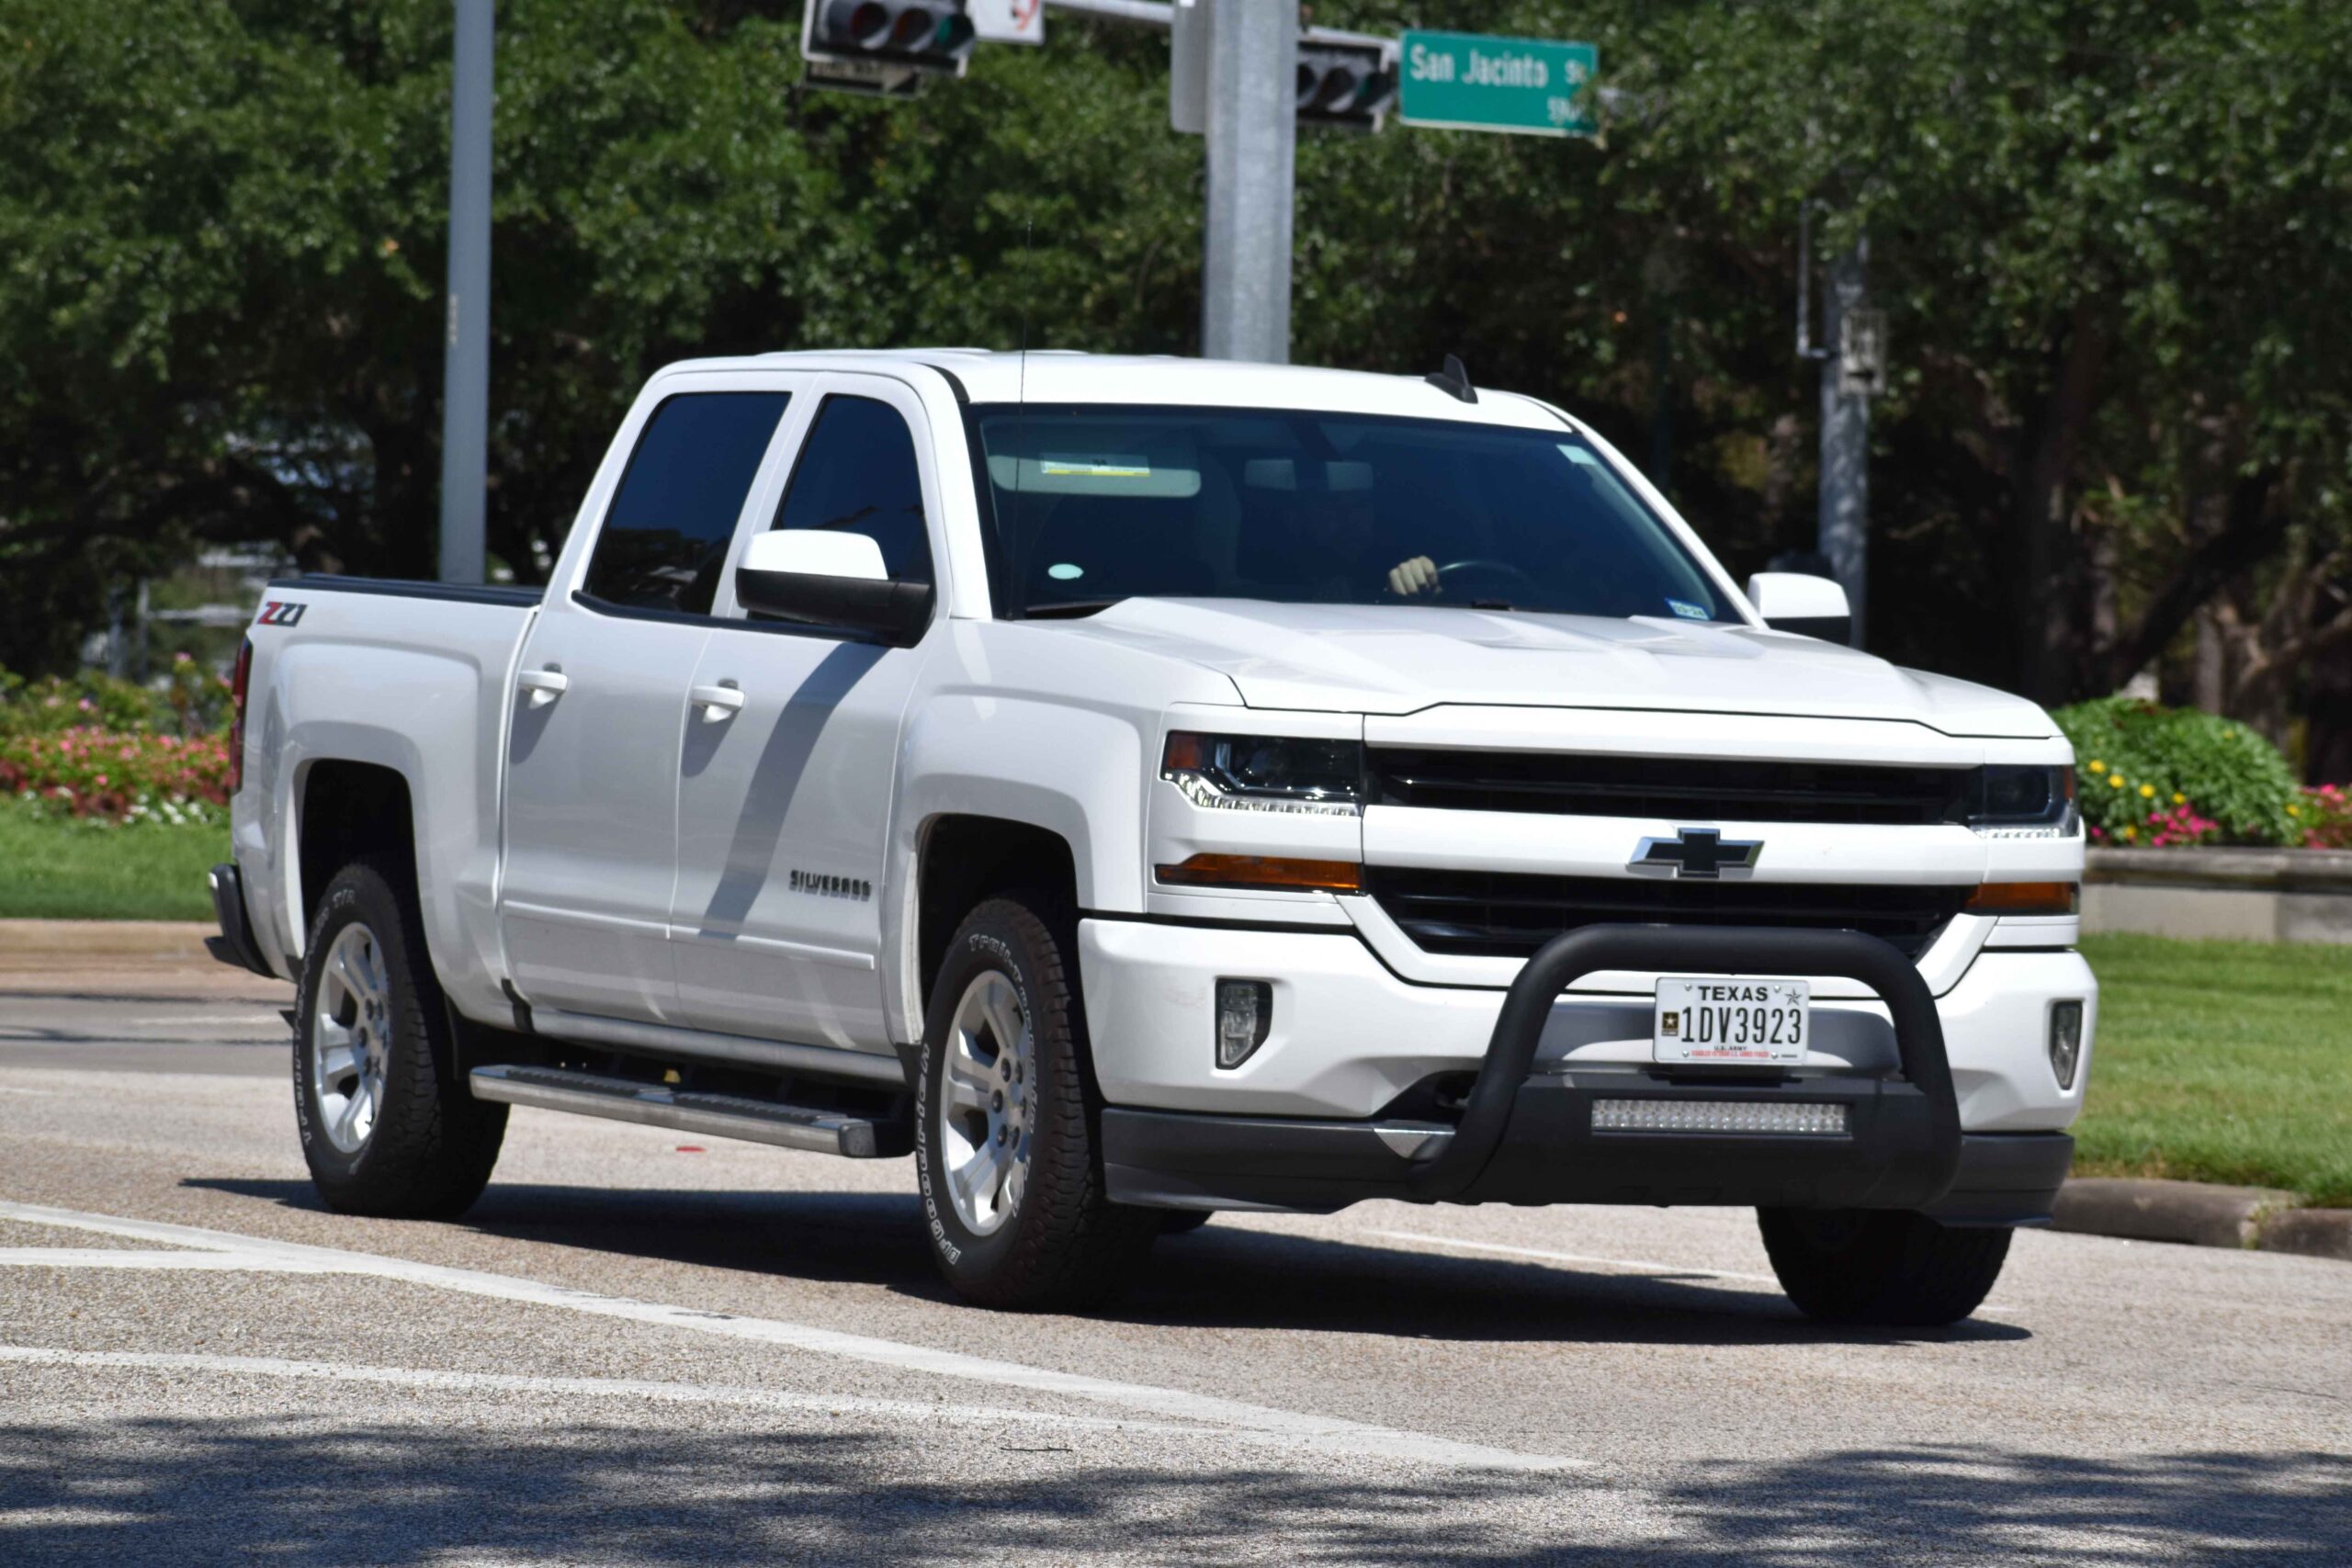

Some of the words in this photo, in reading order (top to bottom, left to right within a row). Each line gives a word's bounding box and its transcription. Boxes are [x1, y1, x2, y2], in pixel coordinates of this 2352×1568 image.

[1409, 44, 1455, 84] San
[1462, 48, 1549, 88] Jacinto
[790, 869, 872, 897] SILVERADO
[1698, 986, 1769, 1002] TEXAS
[1680, 1006, 1802, 1044] 1DV3923
